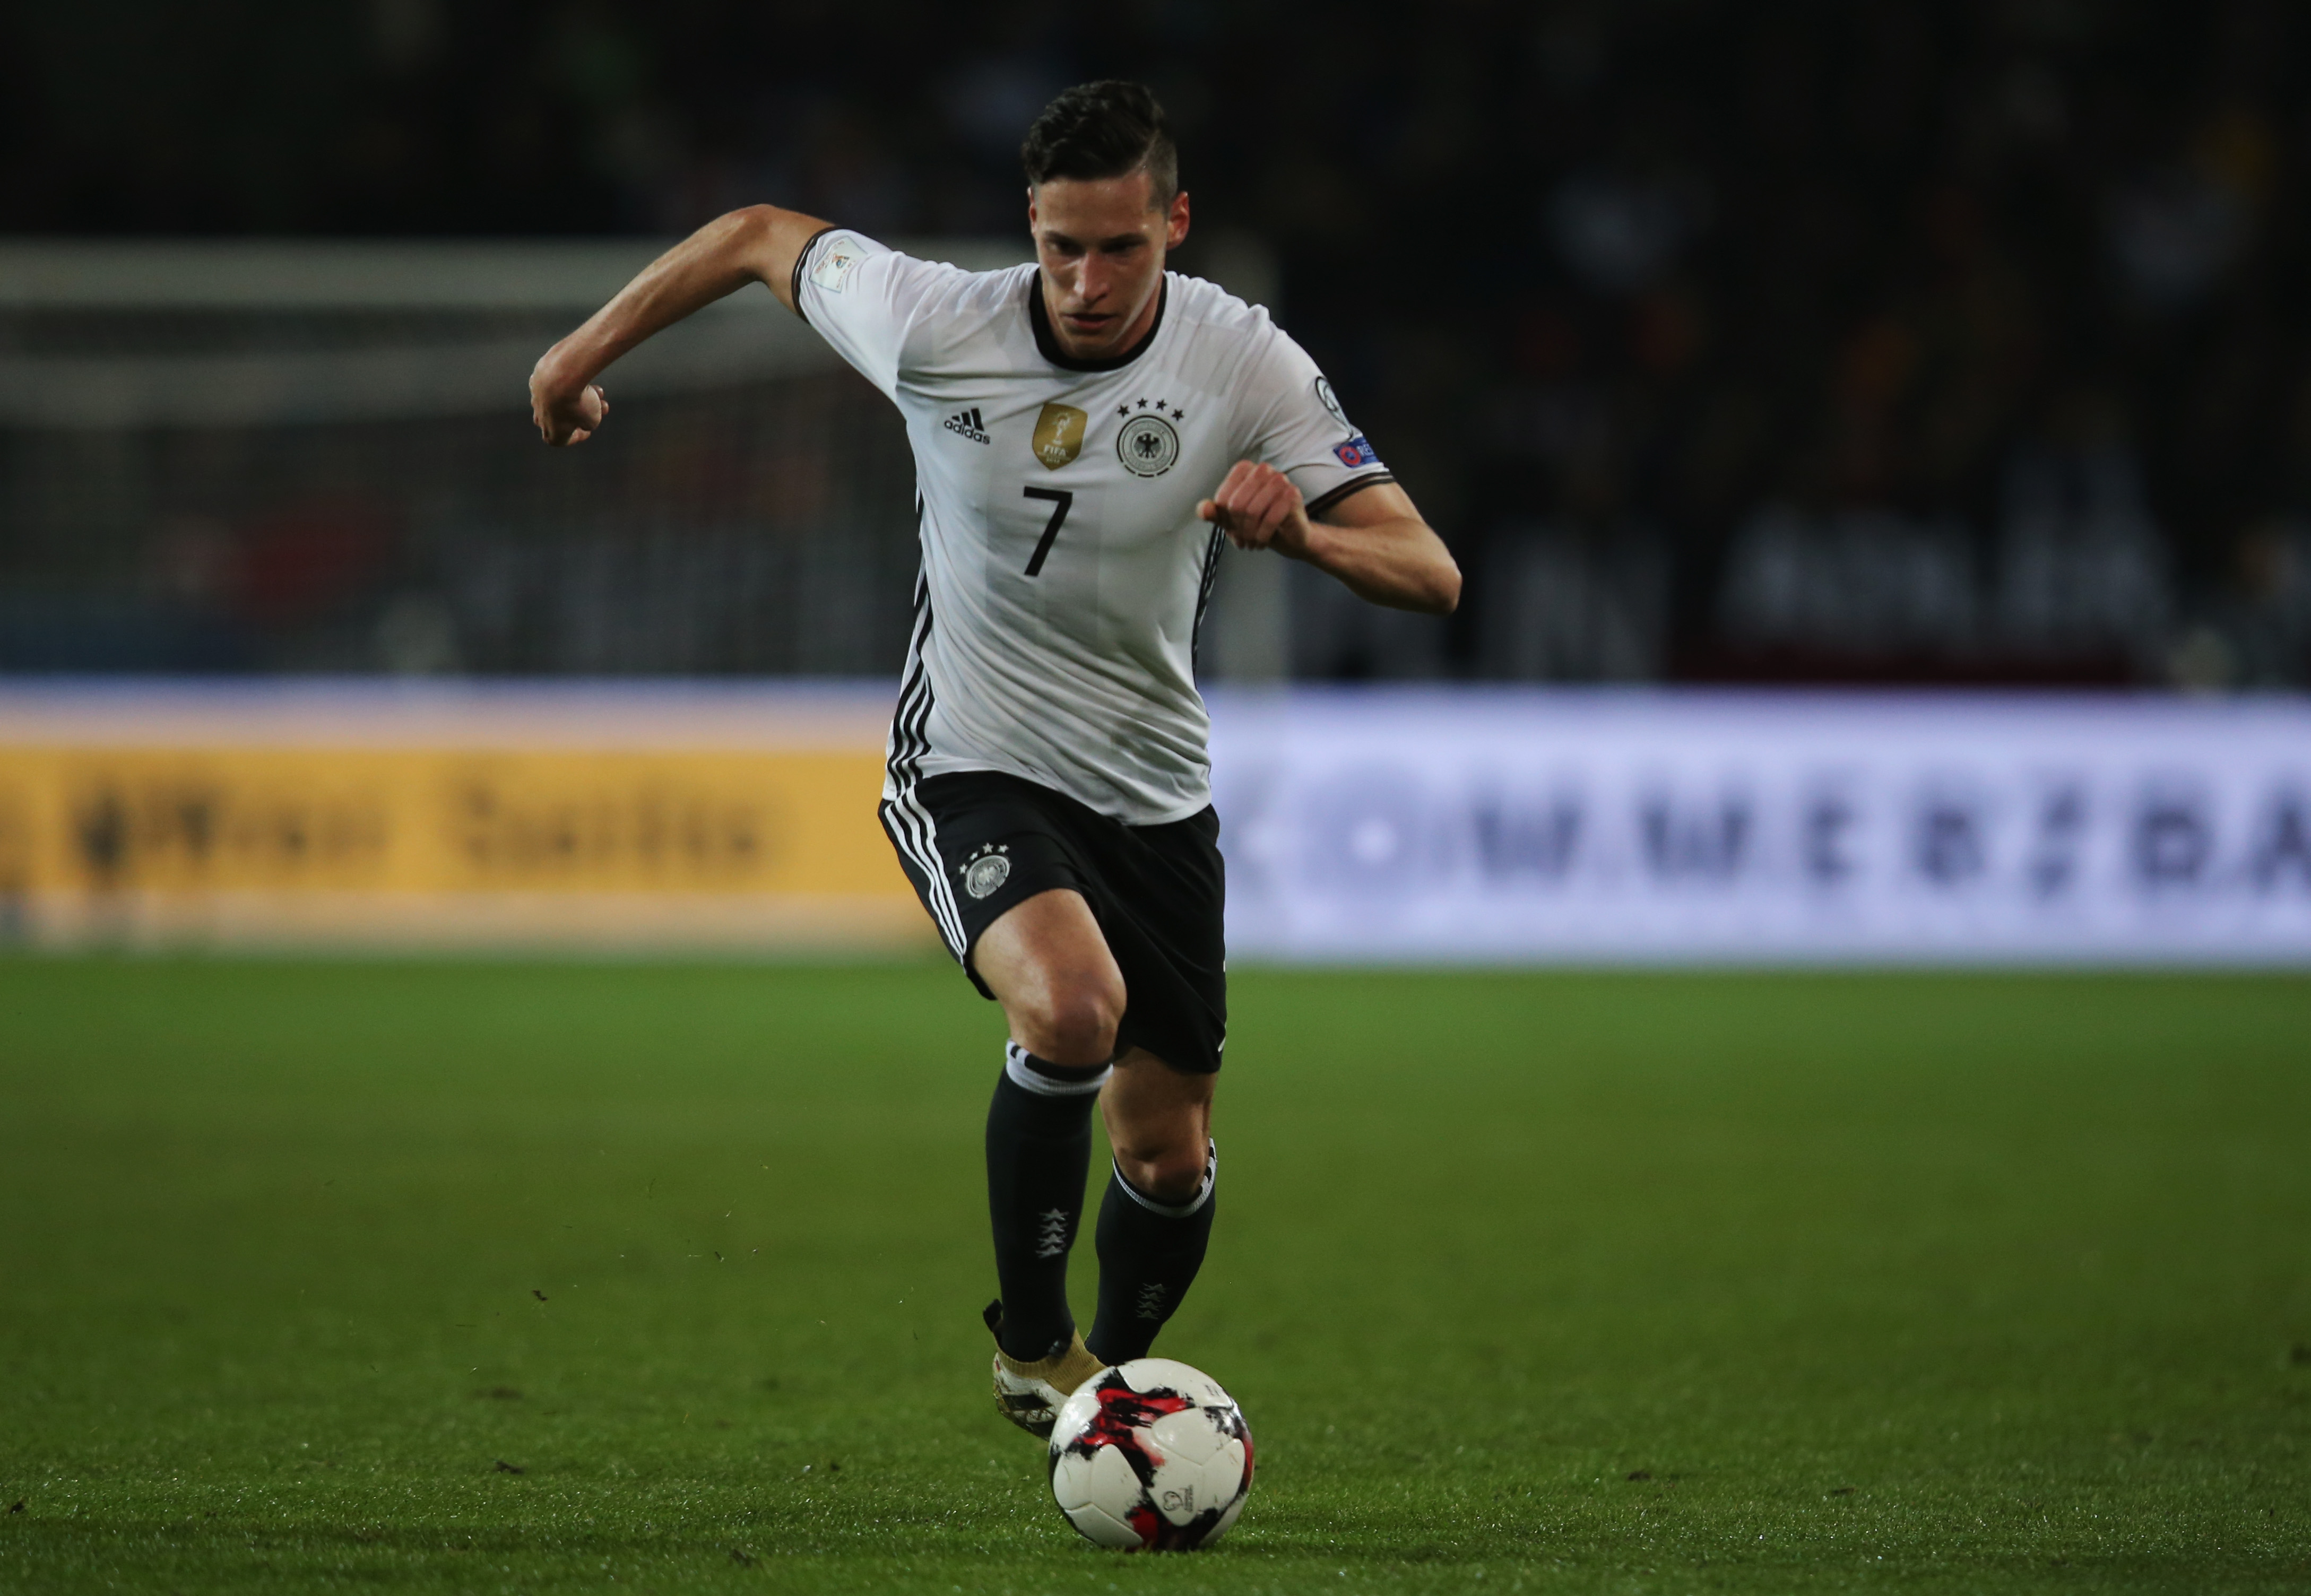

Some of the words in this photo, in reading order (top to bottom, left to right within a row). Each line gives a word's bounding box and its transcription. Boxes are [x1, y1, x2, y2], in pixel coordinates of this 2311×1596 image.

[945, 421, 990, 445] adidas
[1044, 445, 1066, 456] FIFA
[1024, 486, 1073, 577] 7
